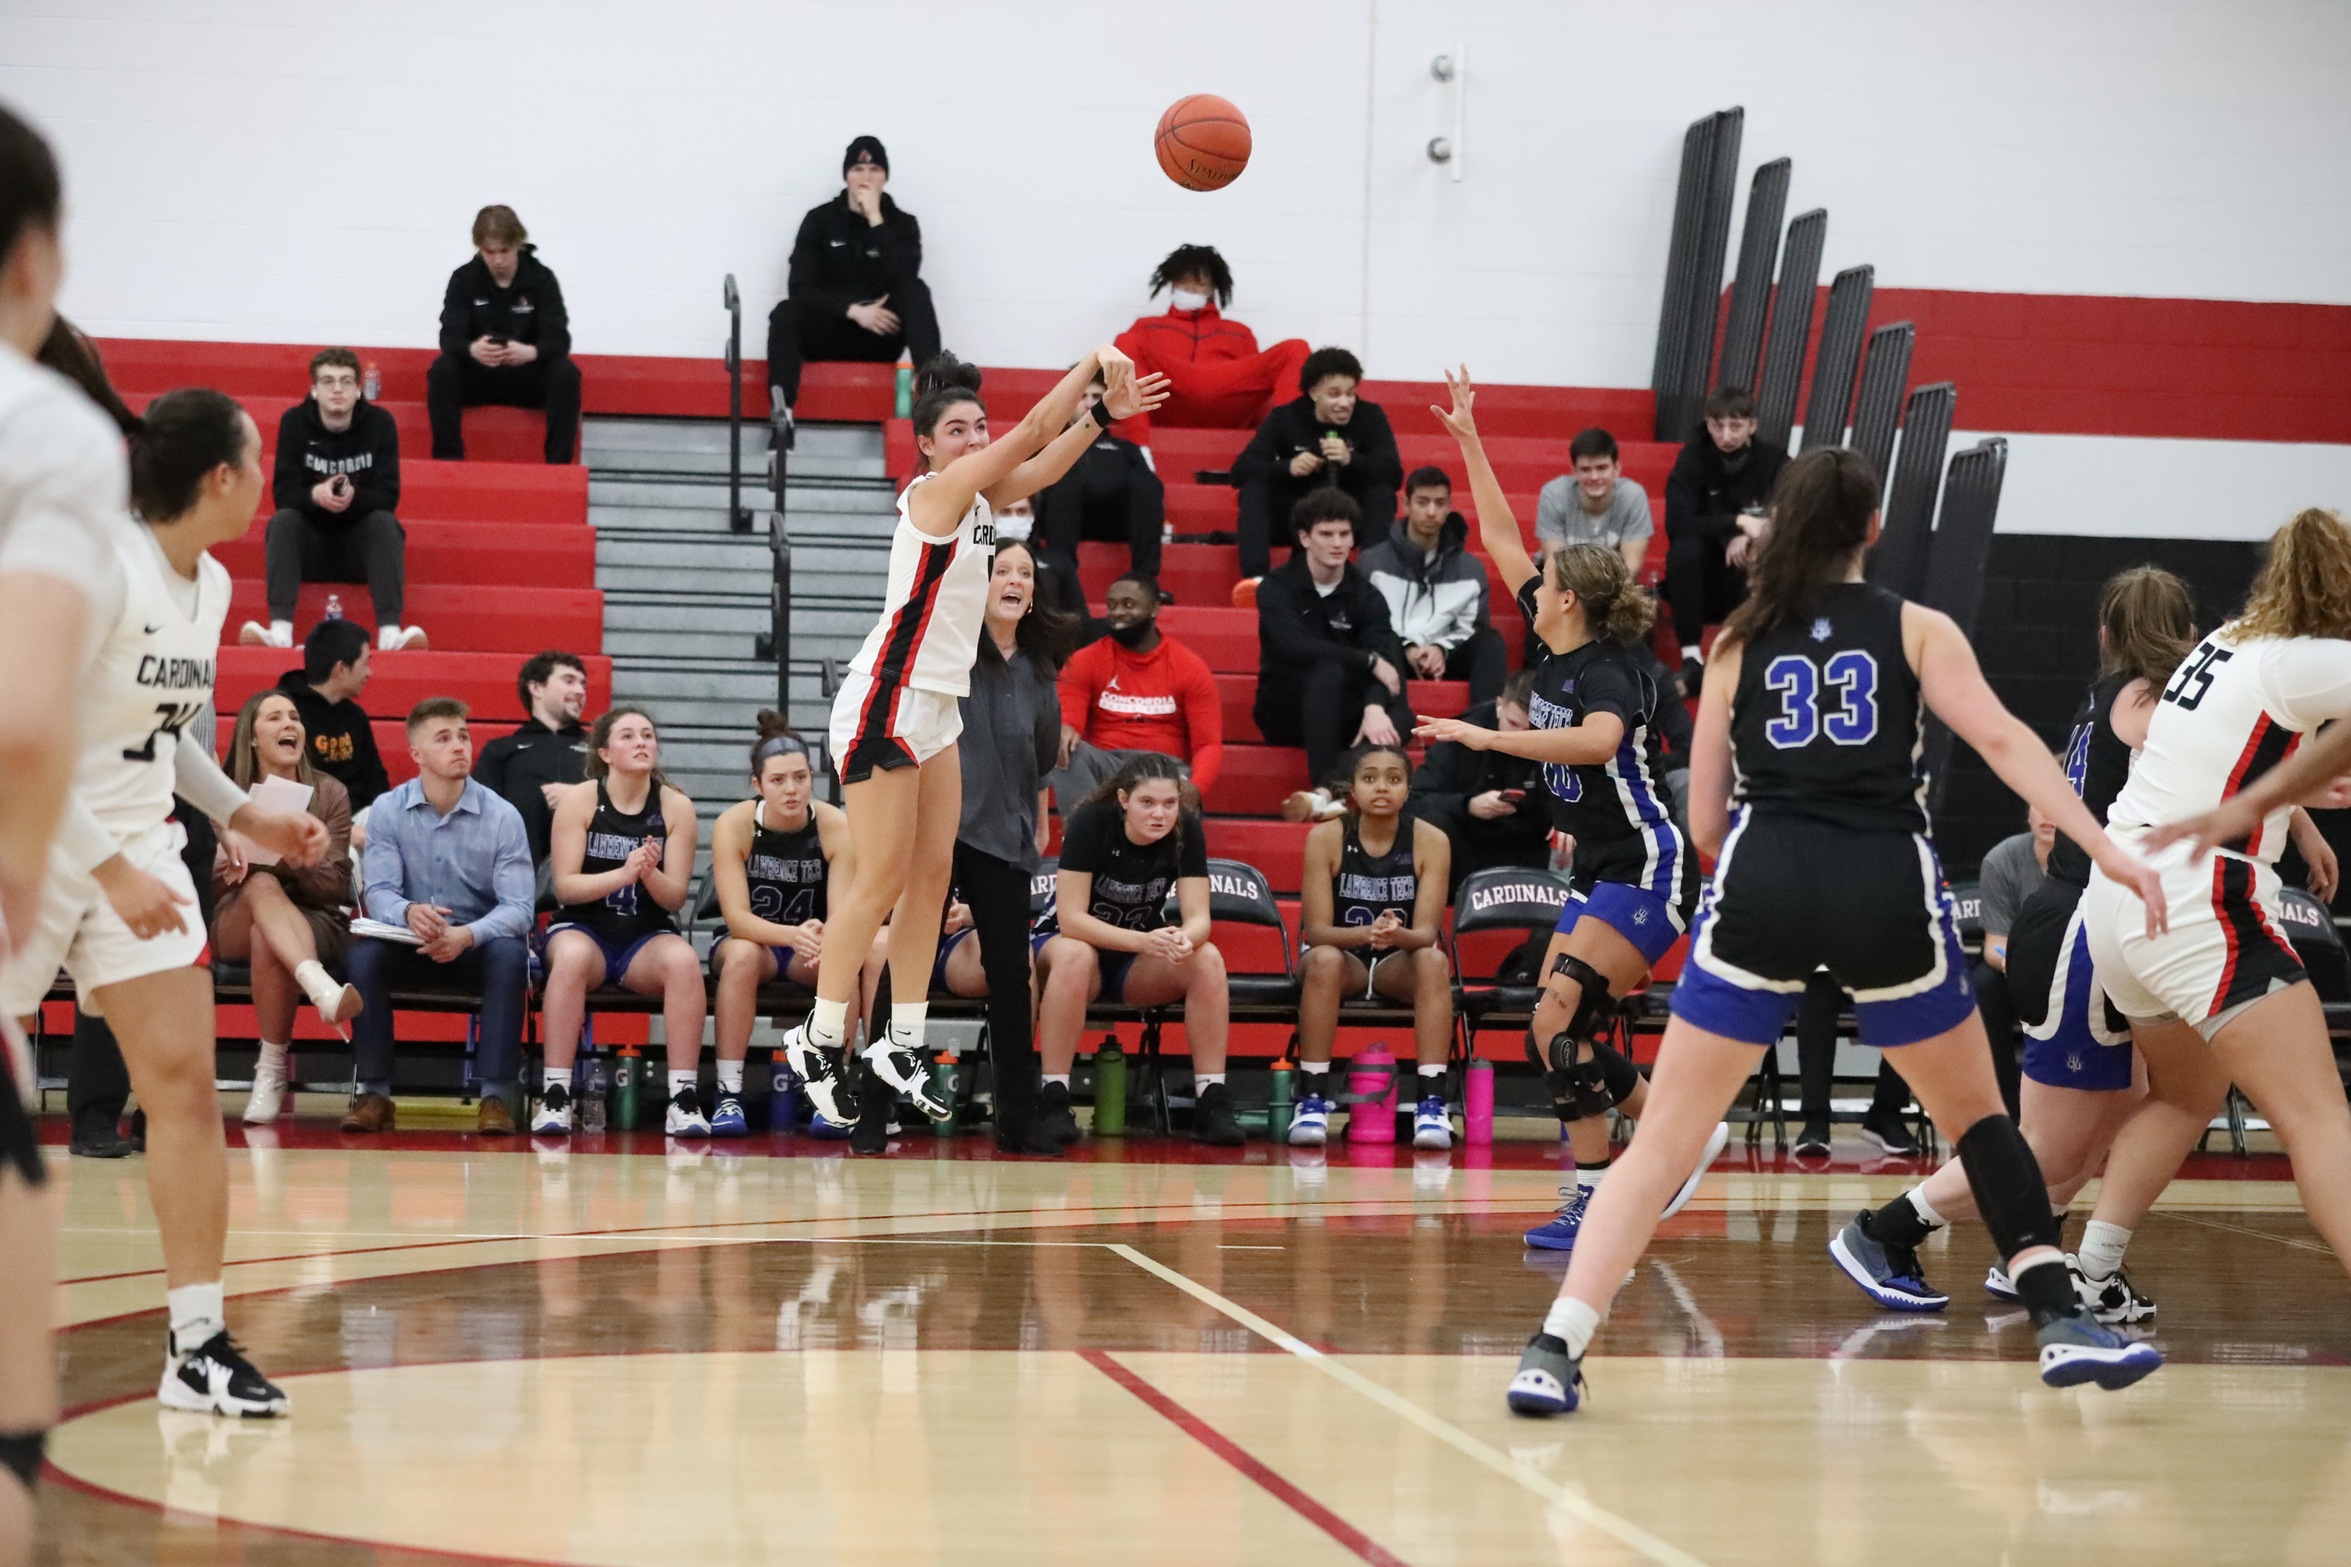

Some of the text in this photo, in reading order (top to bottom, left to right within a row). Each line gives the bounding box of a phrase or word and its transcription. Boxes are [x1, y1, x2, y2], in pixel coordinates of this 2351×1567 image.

[1185, 158, 1240, 182] SPALD
[136, 654, 215, 689] CARDINA
[2163, 641, 2234, 711] 35
[1101, 690, 1175, 706] CONCORDIA
[1764, 649, 1878, 750] 33
[2061, 720, 2094, 800] 4
[1339, 872, 1415, 902] LAWRENCE TECH
[1472, 883, 1569, 911] CARDINALS
[751, 884, 814, 924] 24
[615, 1068, 629, 1087] G
